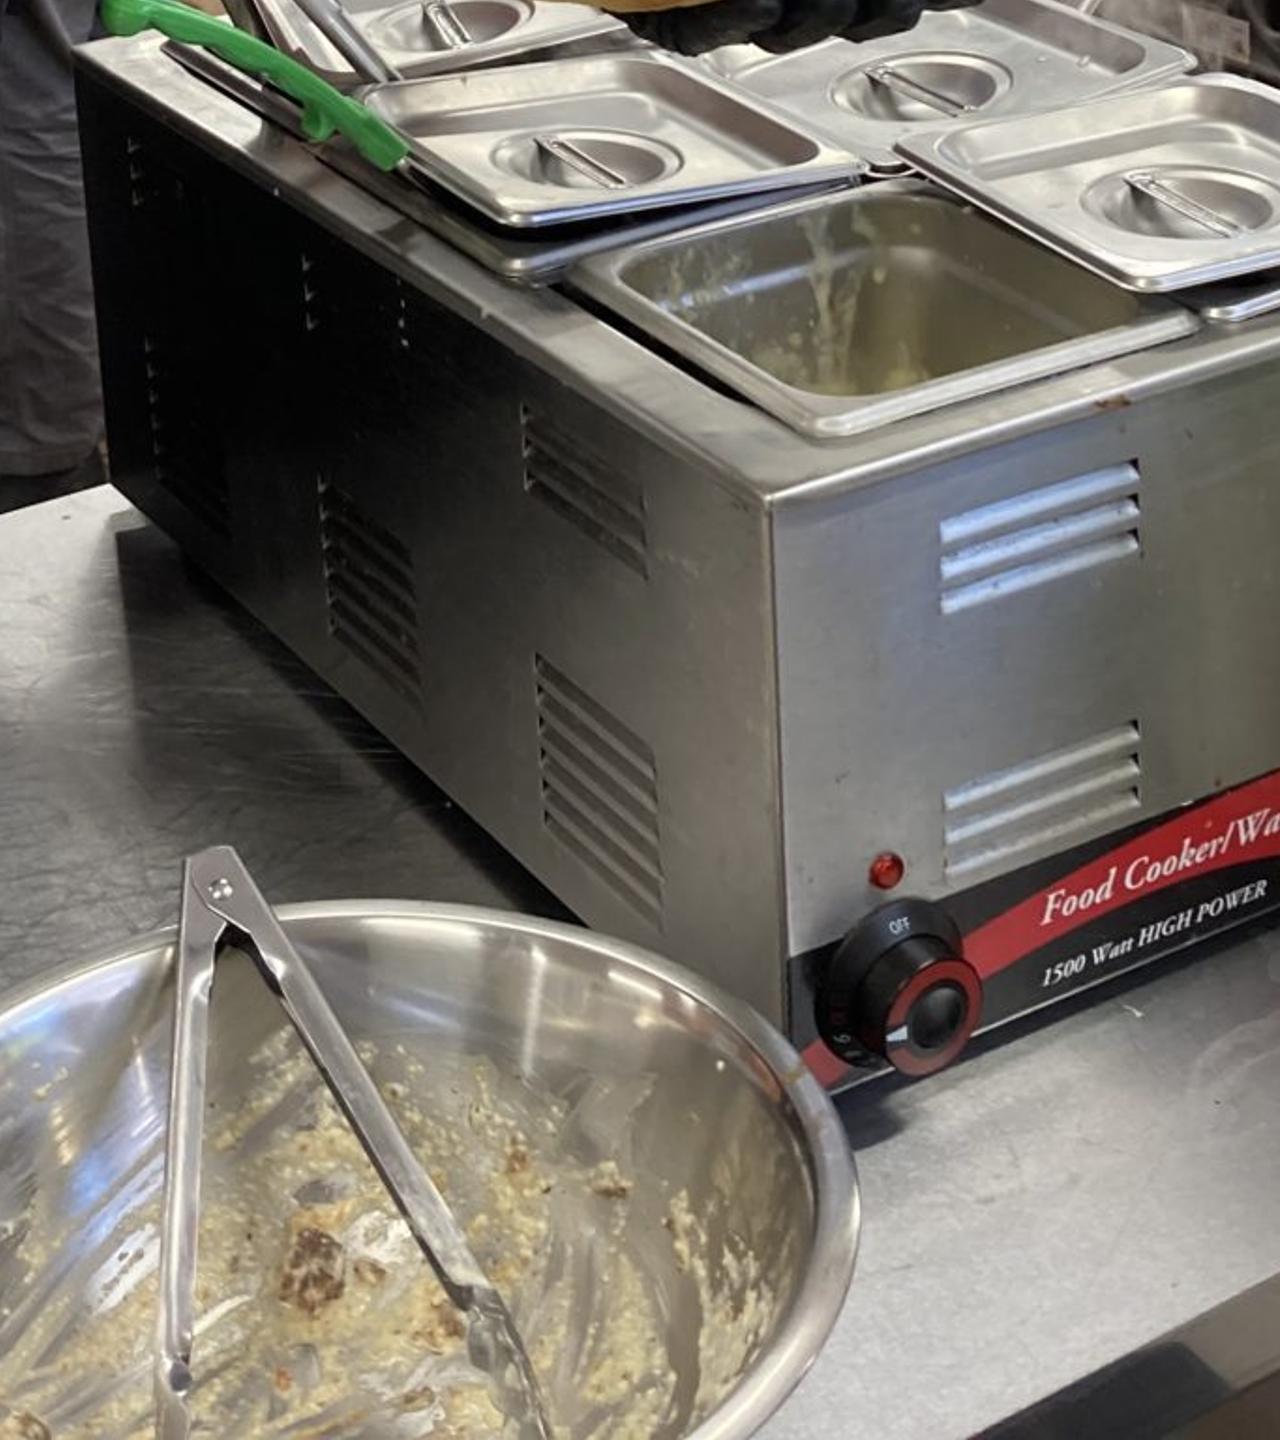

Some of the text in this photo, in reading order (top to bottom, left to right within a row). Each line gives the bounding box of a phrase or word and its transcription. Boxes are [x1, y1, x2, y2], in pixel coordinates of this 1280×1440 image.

[888, 916, 911, 936] OFF
[1040, 867, 1118, 927] Food
[1042, 878, 1268, 987] 1500 Watt HIGH POWER
